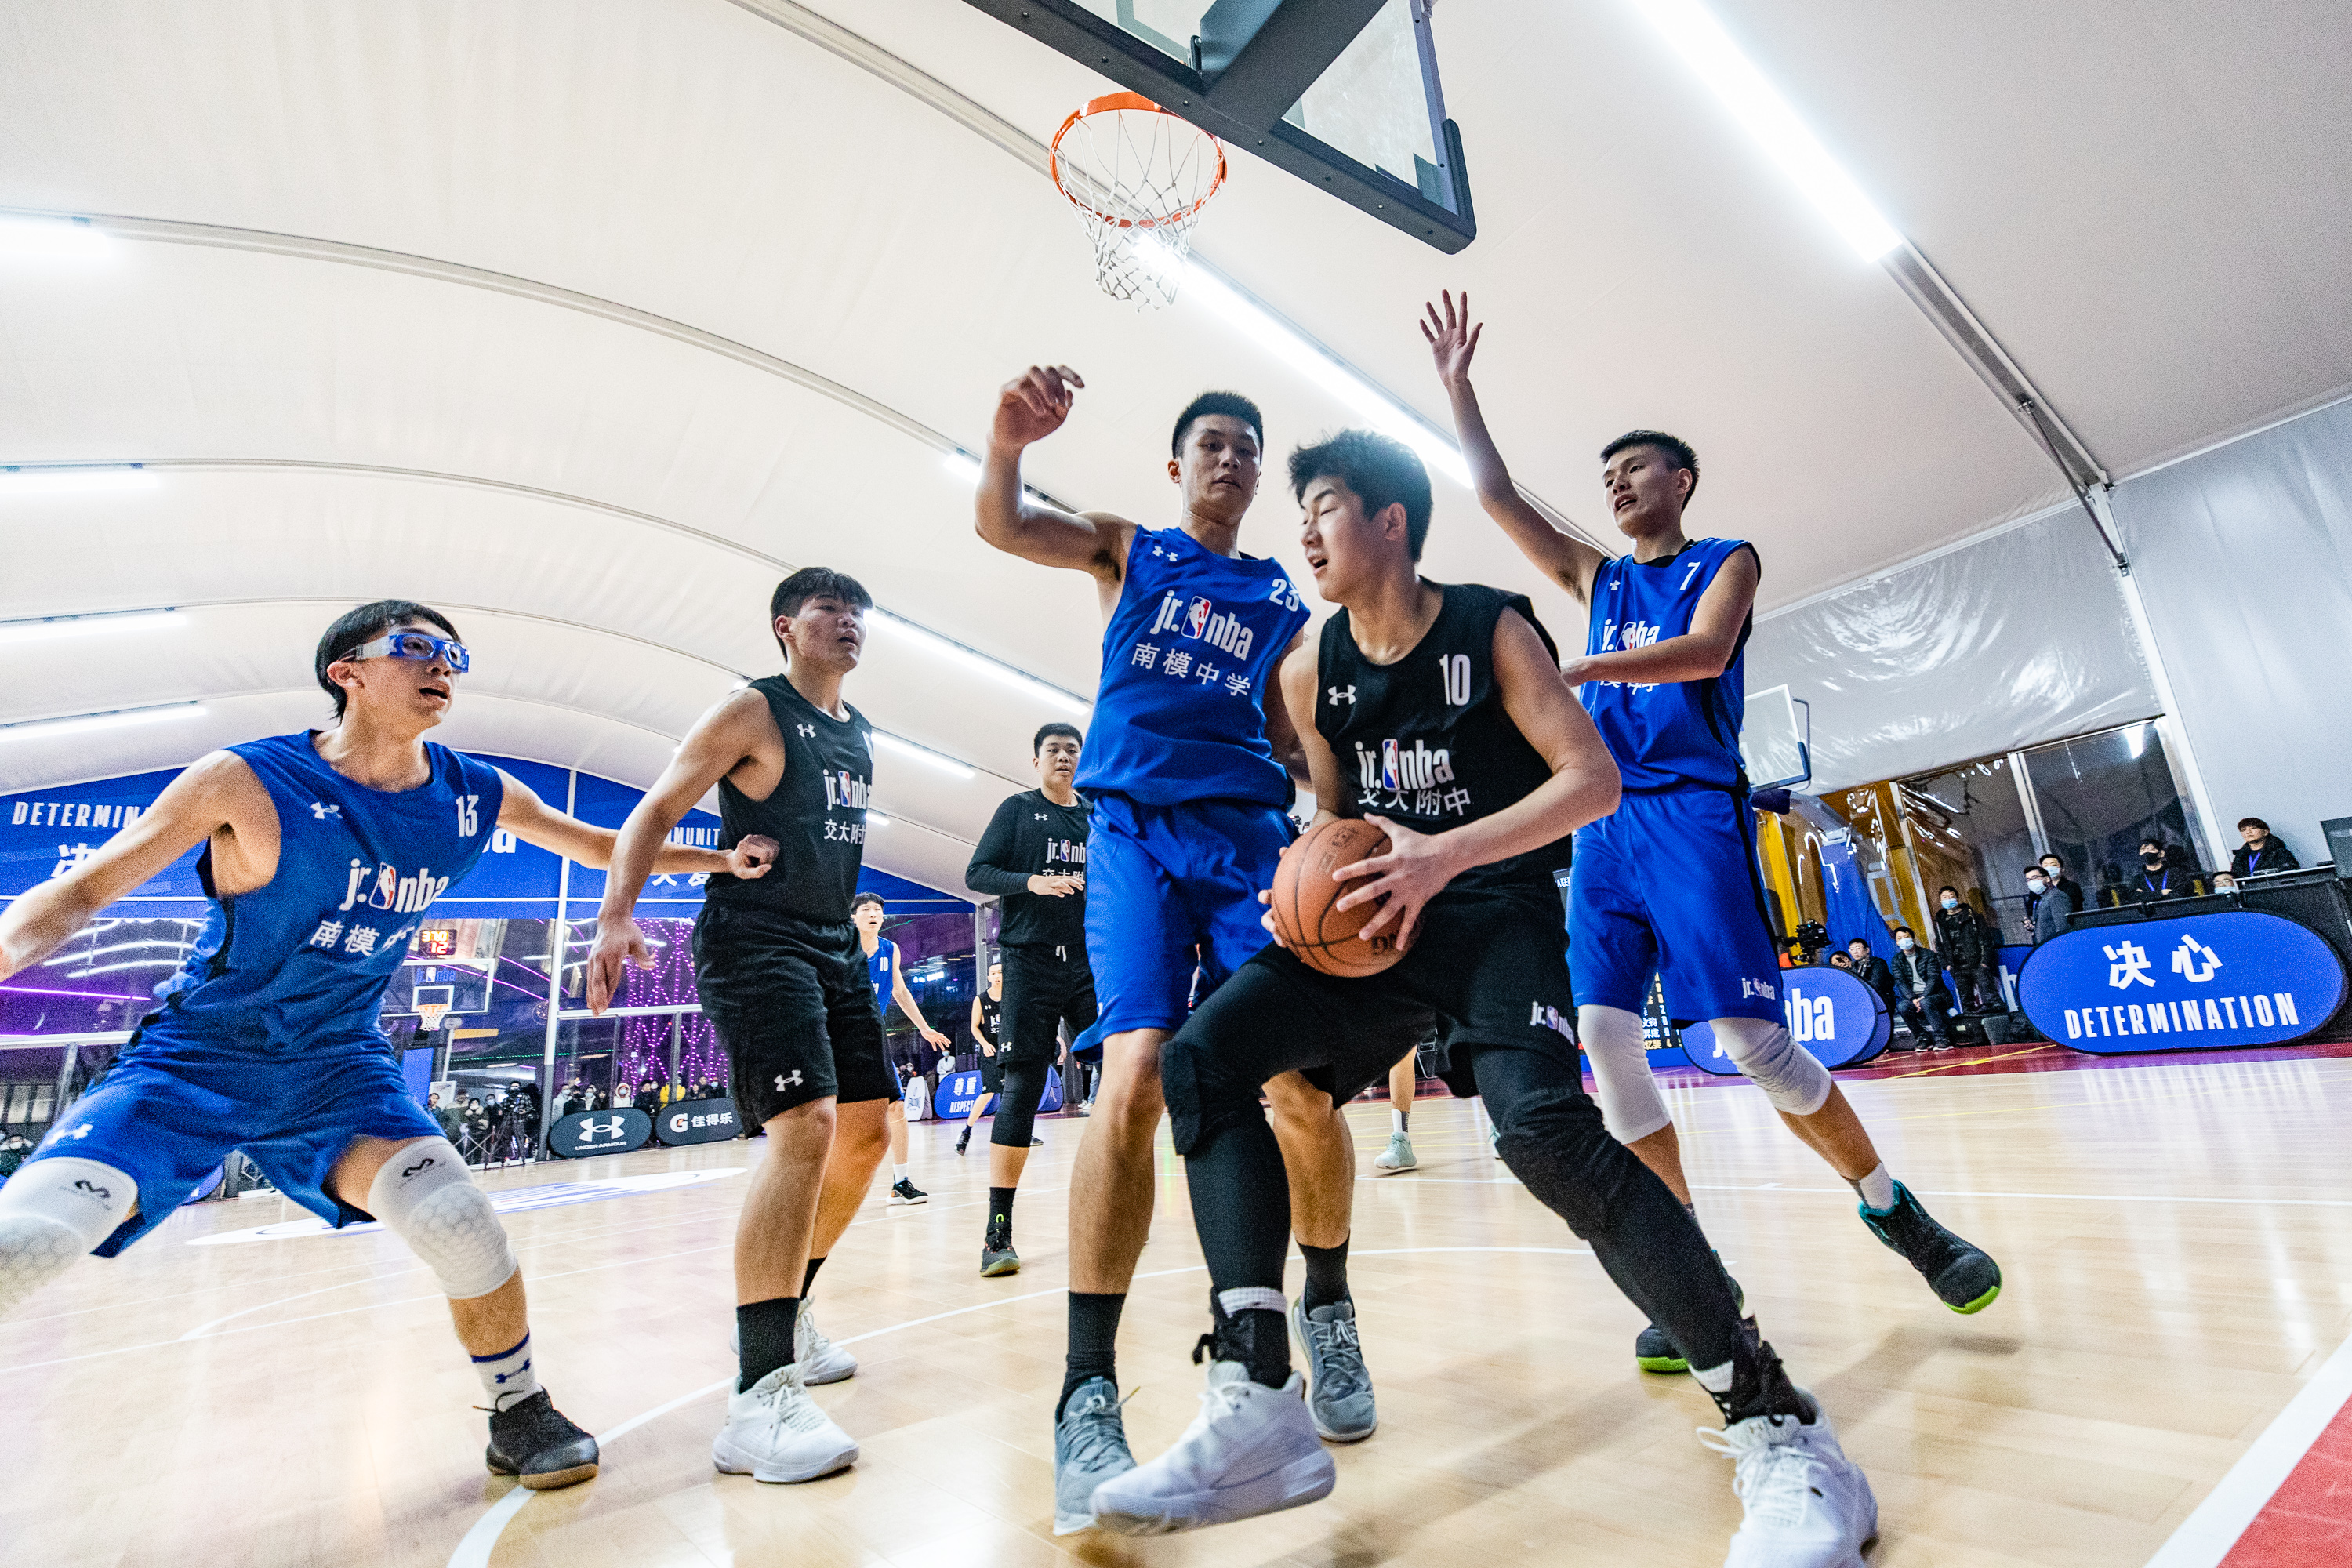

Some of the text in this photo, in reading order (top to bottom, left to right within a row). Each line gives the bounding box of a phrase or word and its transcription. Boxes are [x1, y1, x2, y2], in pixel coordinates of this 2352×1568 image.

[1679, 561, 1701, 590] 7
[1269, 578, 1300, 612] 23
[1149, 590, 1254, 661] jr. nba
[1131, 642, 1251, 697] 南模中学
[1439, 653, 1471, 706] 10
[1355, 739, 1455, 790] jr. nba
[823, 769, 840, 811] jr.
[12, 801, 151, 829] DETERMIN
[456, 794, 479, 837] 13
[1045, 837, 1060, 863] jr.
[339, 858, 372, 911] jr.
[880, 956, 889, 971] 10
[2102, 934, 2223, 990] 决心
[1741, 978, 1755, 999] jr.
[1530, 1000, 1546, 1026] jr.
[2064, 992, 2299, 1040] DETERMINATION
[953, 1076, 977, 1096] 尊重
[691, 1111, 734, 1129] 佳得乐
